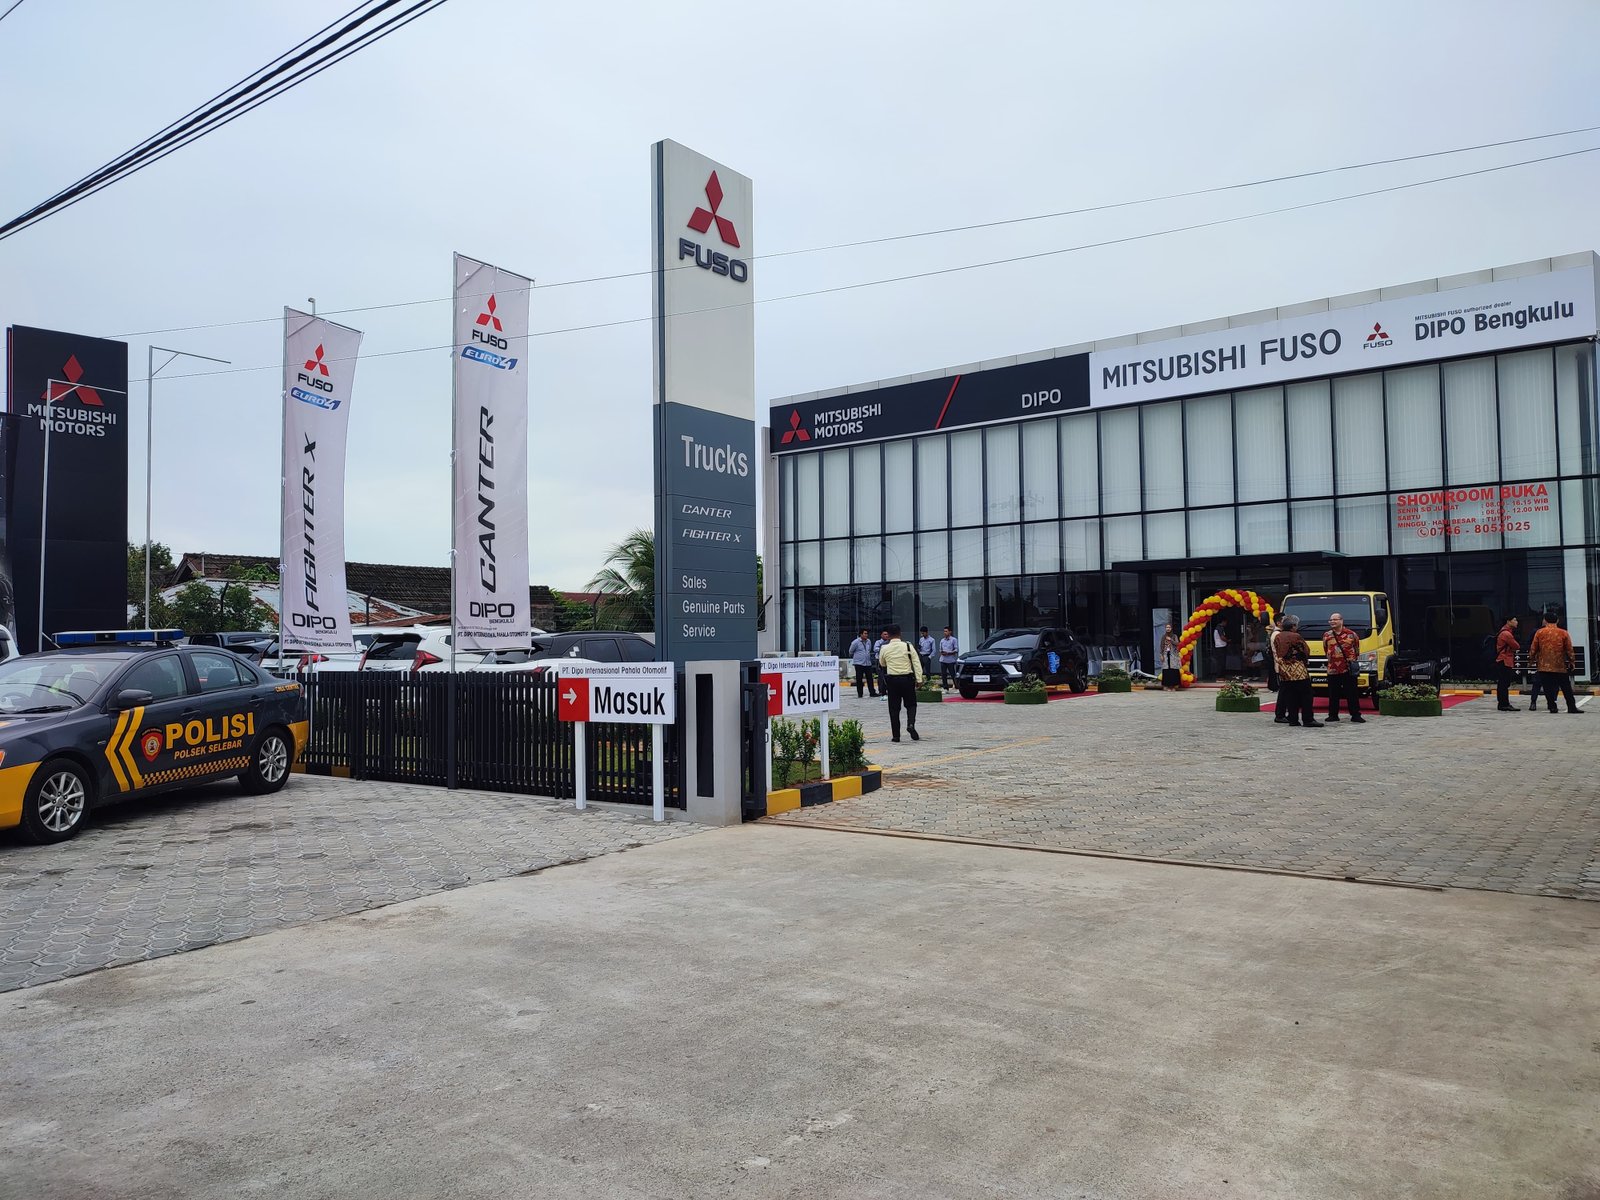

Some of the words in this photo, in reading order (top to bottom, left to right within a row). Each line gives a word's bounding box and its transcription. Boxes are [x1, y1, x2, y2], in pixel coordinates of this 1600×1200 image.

[679, 237, 748, 283] FUSO
[1414, 311, 1447, 321] MITSUBISHI
[1463, 304, 1493, 314] authorized
[1493, 301, 1512, 309] dealer
[1415, 316, 1466, 341] DIPO
[1474, 301, 1574, 332] Bengkulu
[472, 329, 508, 350] FUSO
[1363, 339, 1393, 350] FUSO
[1102, 344, 1246, 390] MITSUBISHI
[1260, 328, 1342, 366] FUSO
[297, 372, 334, 393] FUSO
[1021, 388, 1062, 409] DIPO
[27, 403, 117, 425] MITSUBISHI
[814, 403, 882, 425] MITSUBISHI
[40, 418, 106, 437] MOTORS
[814, 421, 864, 439] MOTORS
[303, 432, 318, 463] X
[681, 434, 749, 477] Trucks
[478, 405, 496, 594] CANTER
[1397, 487, 1494, 507] SHOWROOM
[1501, 483, 1548, 499] BUKA
[681, 504, 732, 519] CANTER
[1452, 517, 1477, 525] BESAR
[302, 466, 321, 613] FIGHTER
[682, 528, 731, 542] FIGHTER
[733, 533, 743, 543] X
[682, 575, 708, 589] Sales
[470, 601, 515, 618] DIPO
[682, 600, 721, 614] Genuine
[723, 601, 746, 614] Parts
[292, 613, 337, 630] DIPO
[682, 624, 716, 638] Service
[571, 666, 584, 675] Dipo
[585, 666, 620, 674] Internasional
[621, 666, 641, 674] Pahala
[642, 666, 668, 674] Otomotif
[594, 686, 666, 715] Masuk
[787, 679, 836, 707] Keluar
[165, 712, 255, 750] POLISI
[174, 745, 208, 760] POLSEK
[208, 739, 243, 753] SELEBAR
